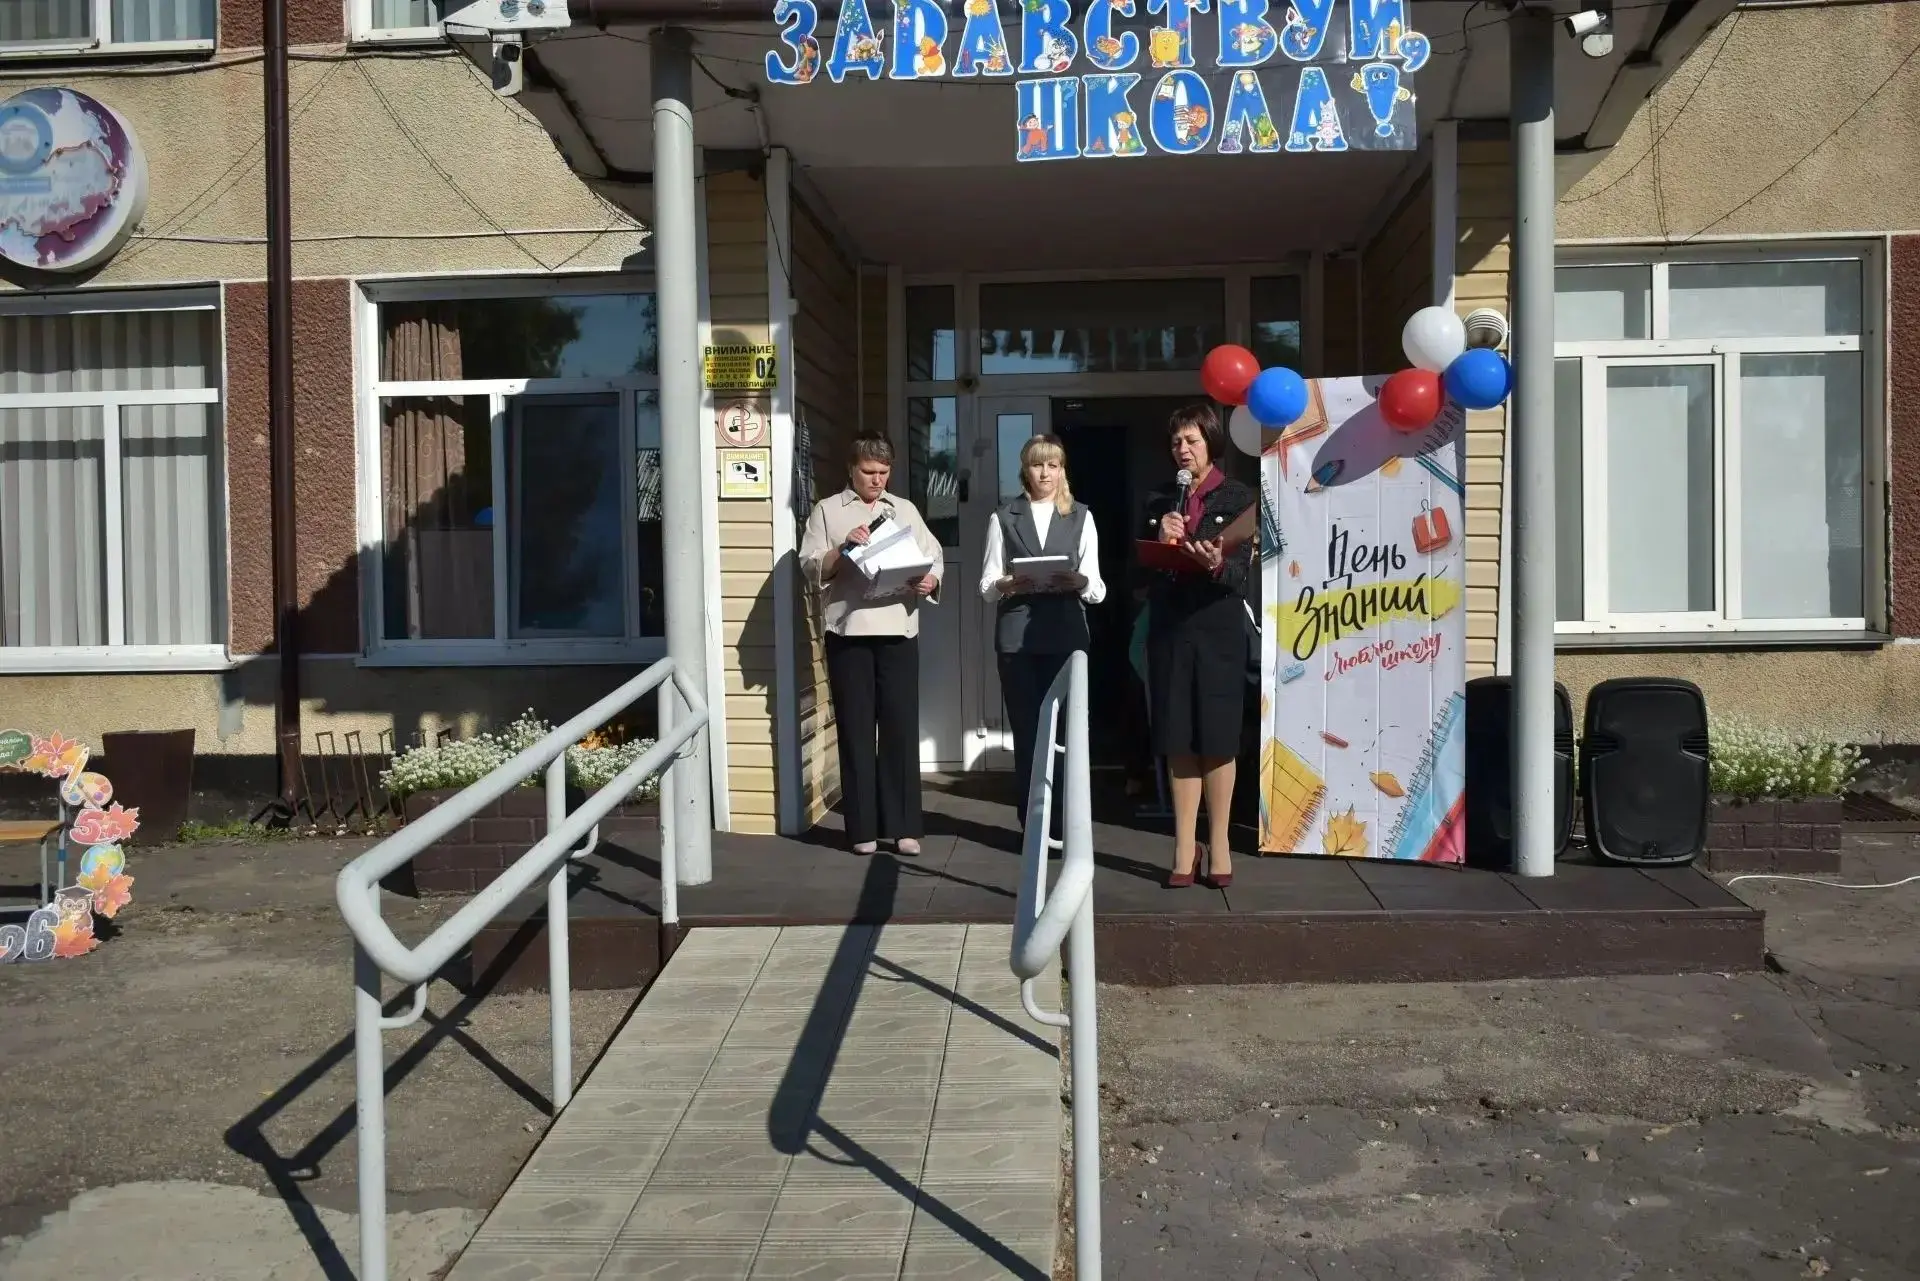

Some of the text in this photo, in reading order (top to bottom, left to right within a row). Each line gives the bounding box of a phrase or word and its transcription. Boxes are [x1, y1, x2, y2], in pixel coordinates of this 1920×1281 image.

[1016, 62, 1410, 161] ШКОЛА!
[705, 345, 775, 355] ВНИМАНИЕ!
[756, 357, 776, 379] 02
[1322, 524, 1407, 590] День
[1292, 572, 1429, 661] Знаний
[1324, 632, 1442, 681] Люблю школу
